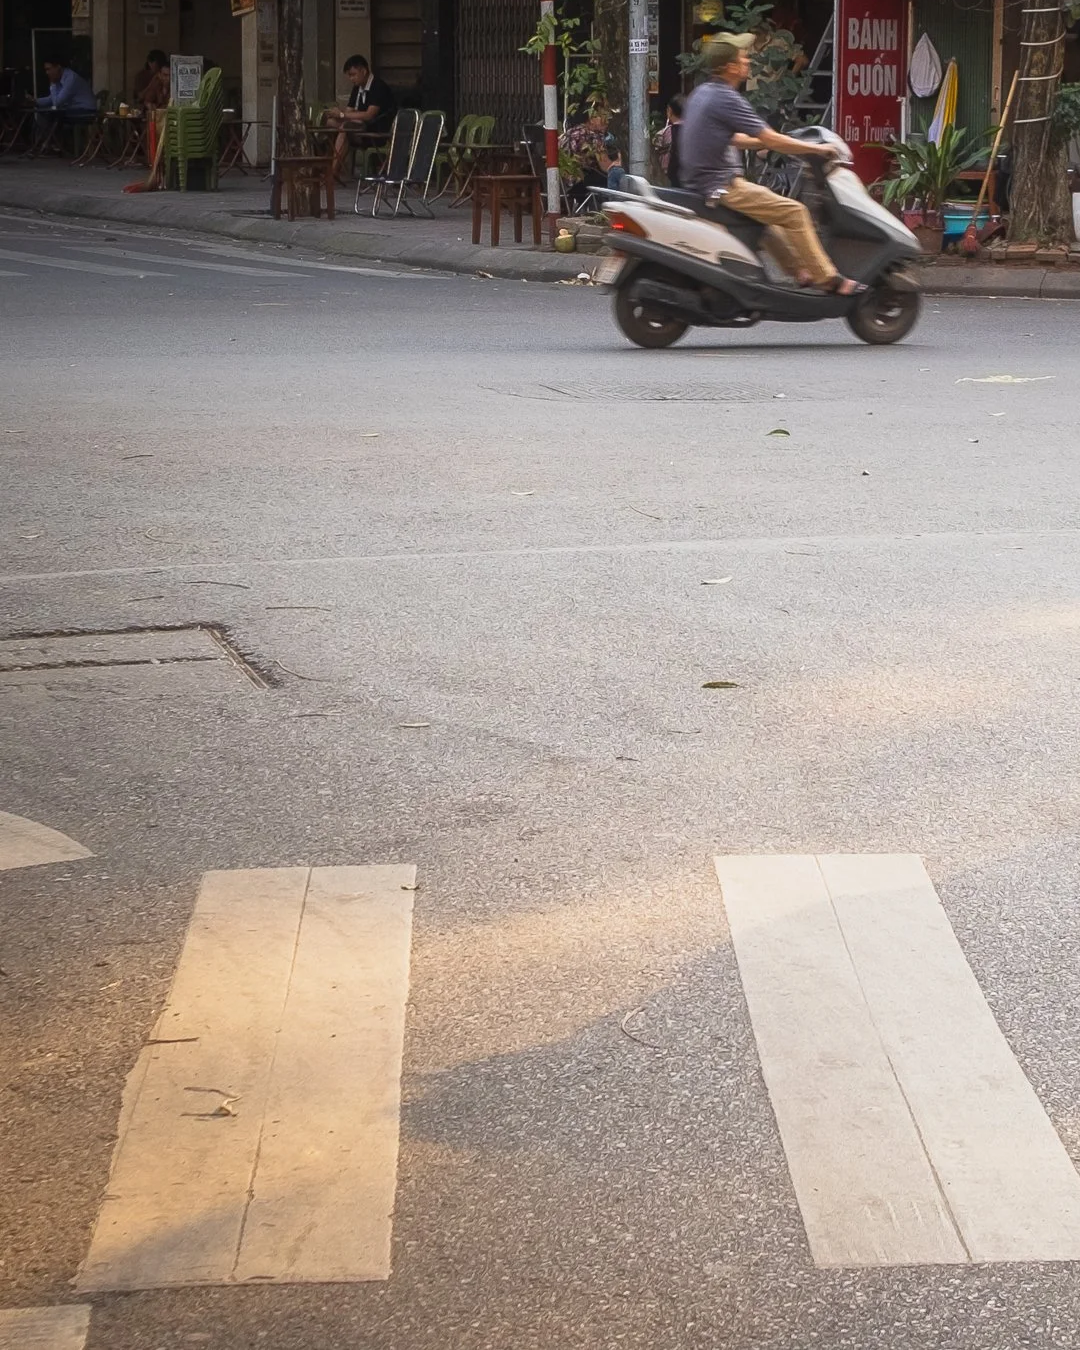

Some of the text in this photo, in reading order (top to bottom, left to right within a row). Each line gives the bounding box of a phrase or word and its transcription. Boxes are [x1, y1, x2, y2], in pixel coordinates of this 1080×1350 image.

[848, 11, 898, 50] BÁNH
[847, 53, 898, 96] CUỐN
[844, 115, 860, 142] Gia
